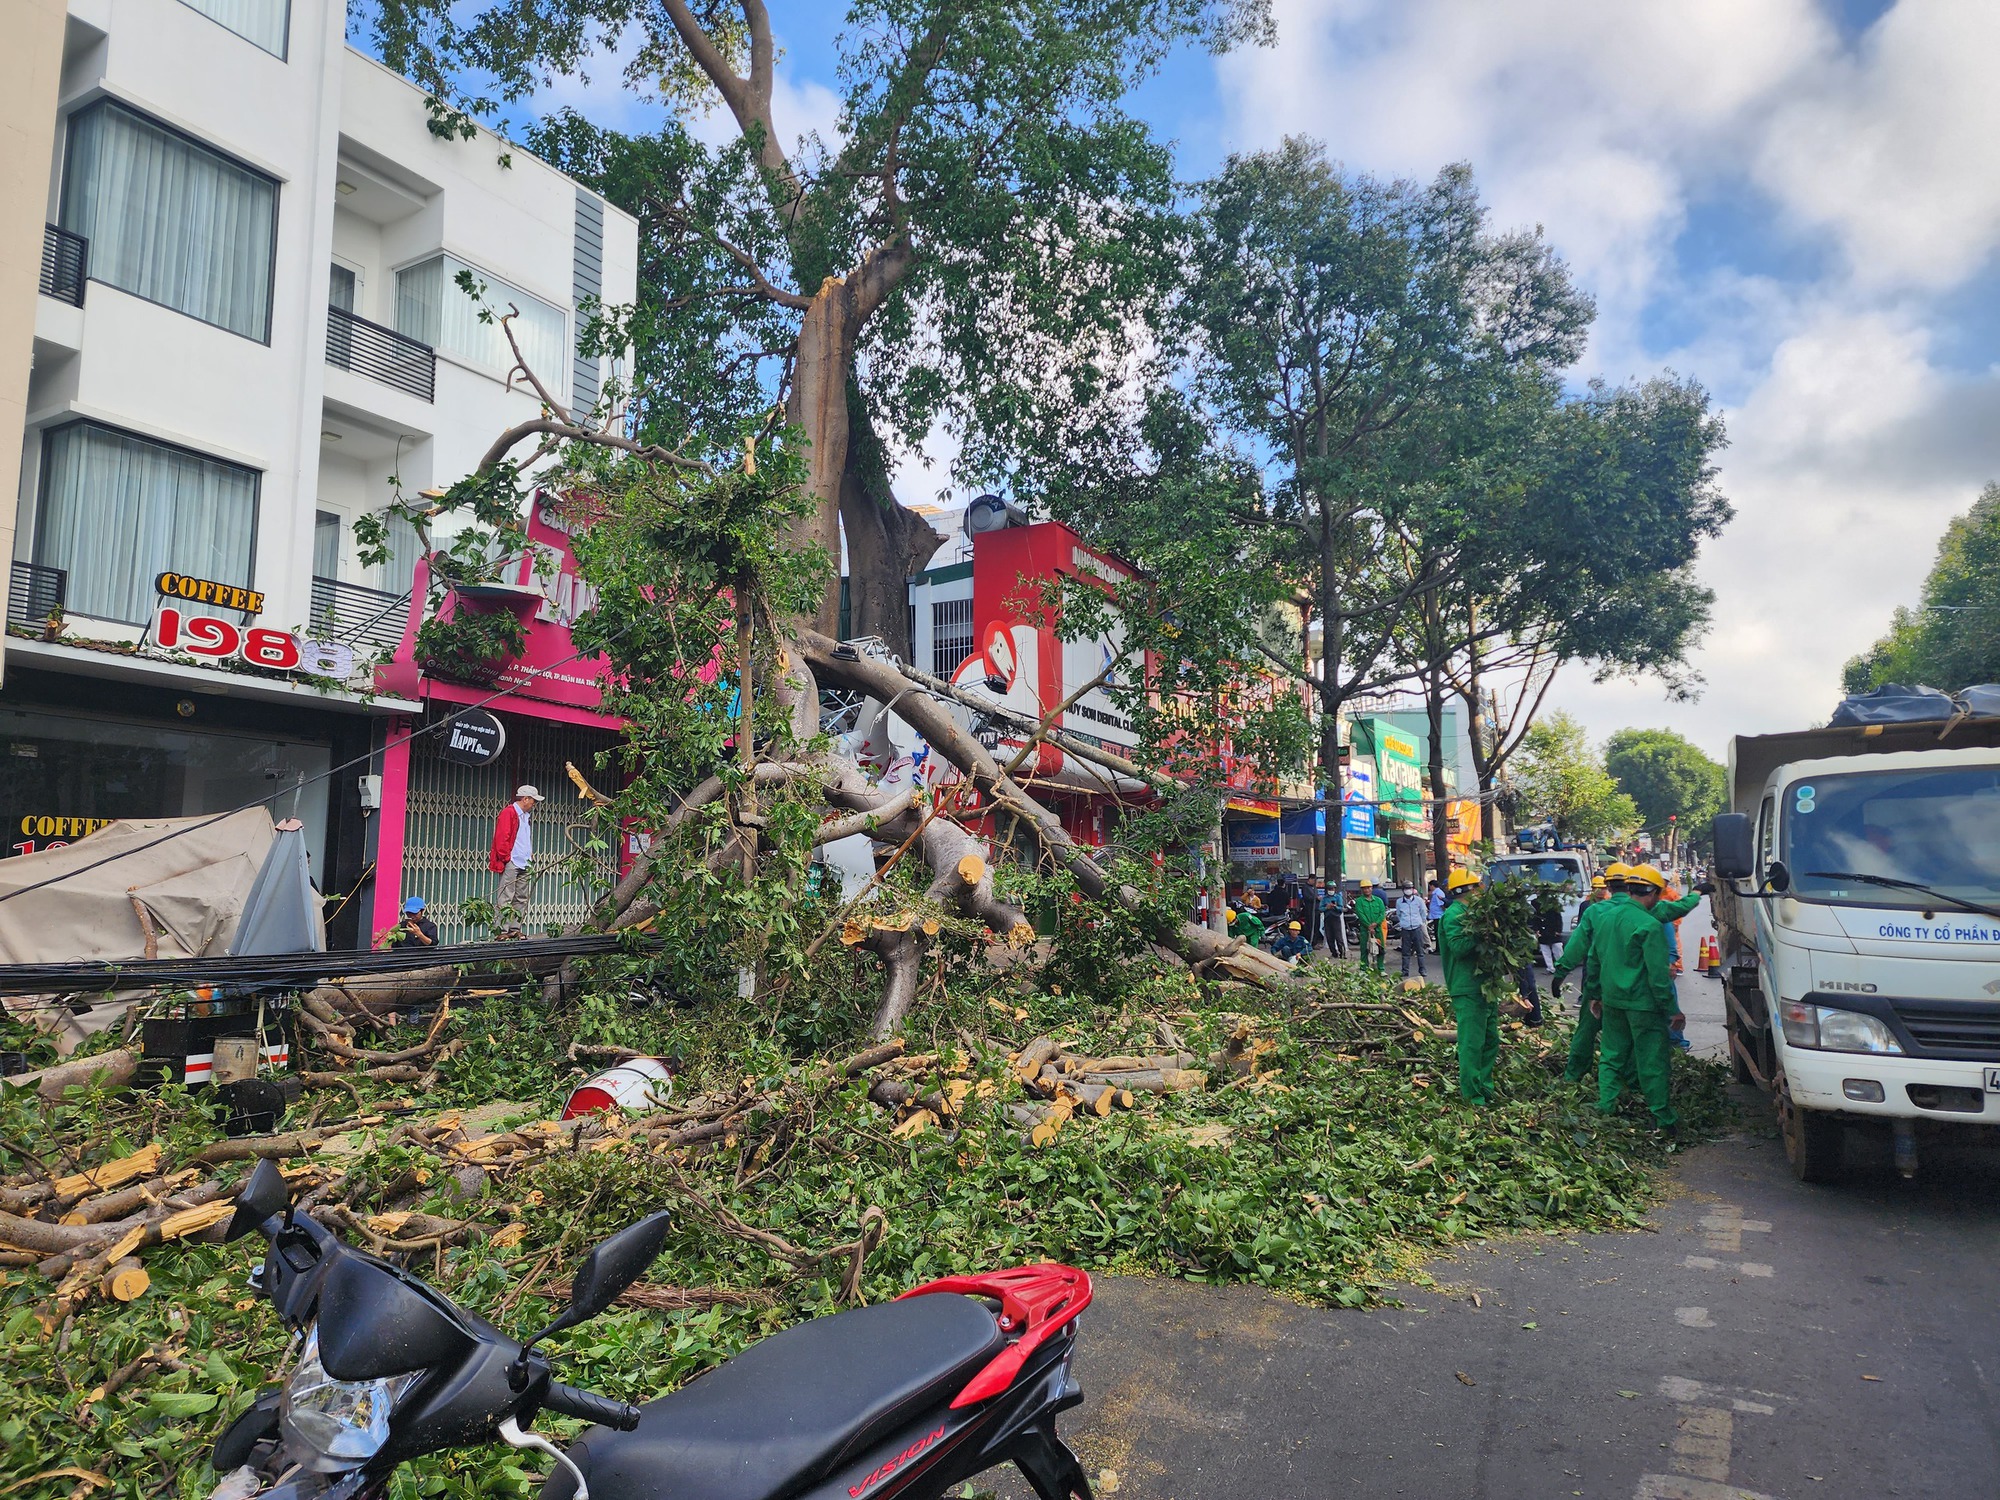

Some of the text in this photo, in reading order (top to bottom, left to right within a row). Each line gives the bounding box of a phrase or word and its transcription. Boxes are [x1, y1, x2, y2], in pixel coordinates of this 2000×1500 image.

[161, 572, 265, 614] COFFEE
[155, 608, 353, 679] 1988
[450, 728, 478, 753] HAPPY
[1381, 750, 1421, 793] Kagawa
[1879, 922, 1911, 939] CÔNG
[1914, 927, 1929, 940] TY
[1934, 922, 1951, 940] CỔ
[1955, 923, 1989, 941] PHẦN
[1819, 980, 1877, 993] HINO
[848, 1424, 946, 1498] VISION
